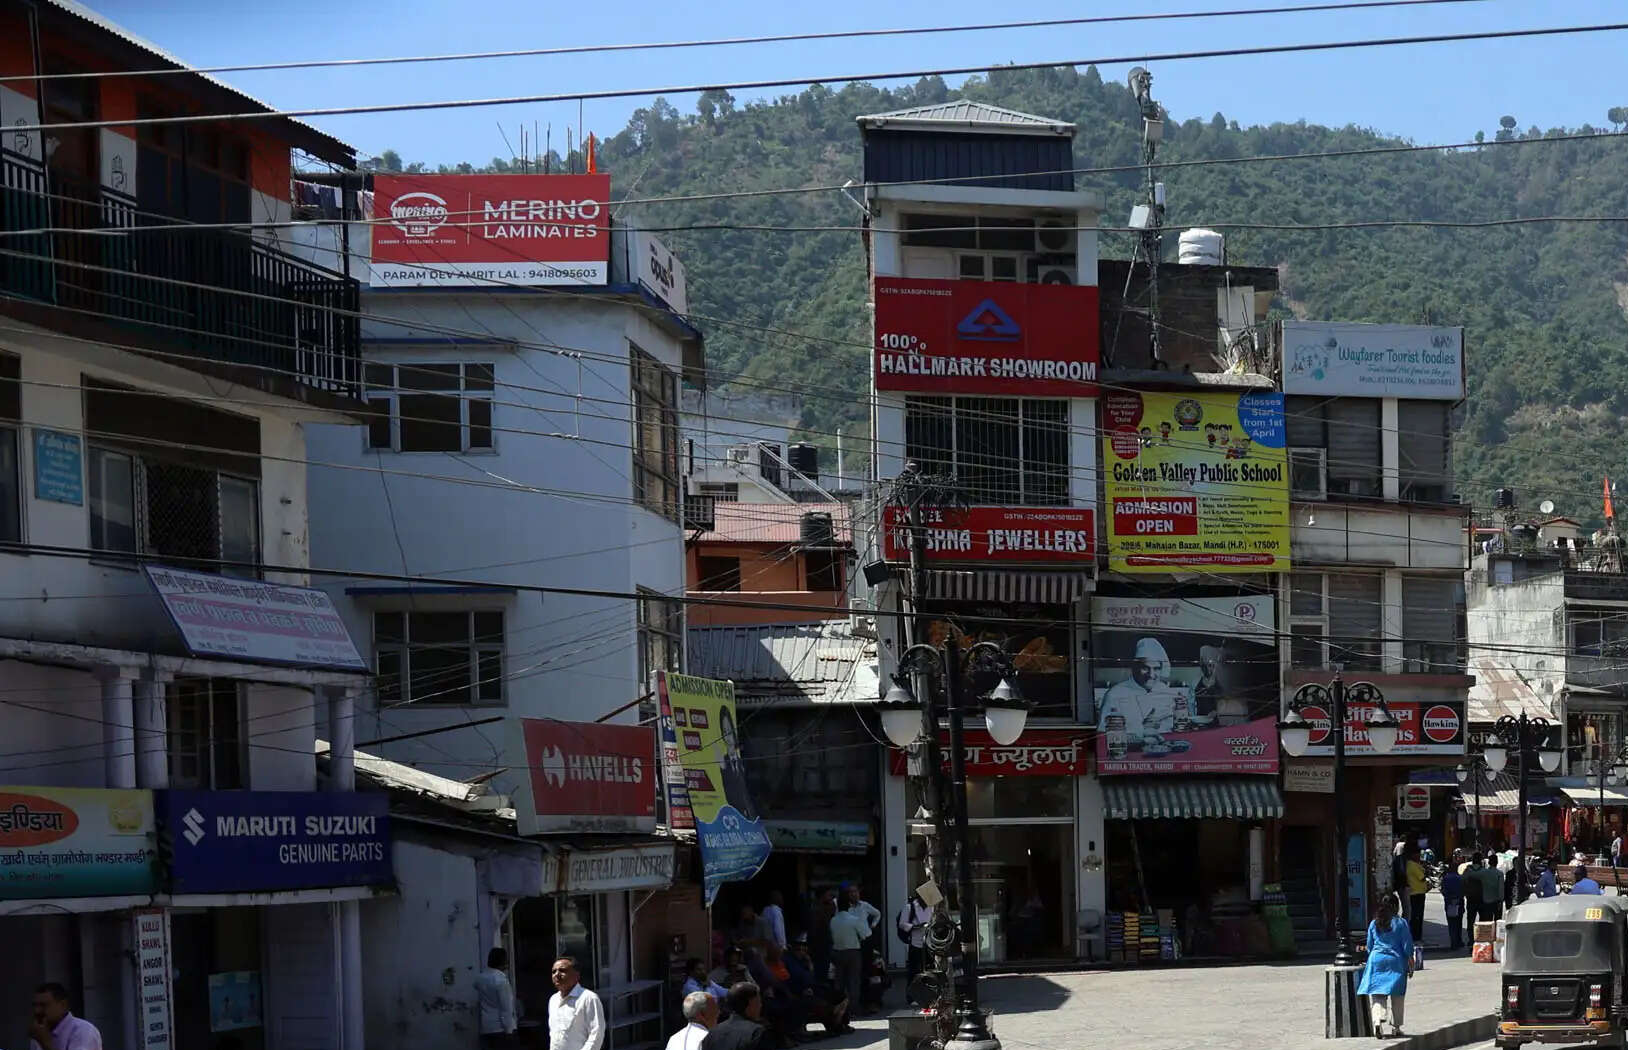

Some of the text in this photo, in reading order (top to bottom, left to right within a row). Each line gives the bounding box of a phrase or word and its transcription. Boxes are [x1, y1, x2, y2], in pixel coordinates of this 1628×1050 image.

[484, 200, 600, 220] MERINO
[484, 225, 598, 238] LAMINATES
[384, 268, 597, 280] PARAM DEV AMRIT LAL 9418095603
[1338, 347, 1456, 366] Wayfarer Tourist foodies
[880, 353, 1096, 381] HALLMARK SHOWROOM
[1243, 398, 1281, 406] Classes
[1251, 408, 1274, 416] Start
[1243, 419, 1283, 427] from 1st
[1252, 429, 1275, 438] April
[1113, 463, 1282, 485] Golden Valley Public School
[1115, 501, 1193, 515] ADMISSION
[893, 509, 943, 524] SHEE
[1136, 519, 1174, 533] OPEN
[893, 528, 1087, 554] KRSHNA JEWELLERS
[1145, 541, 1177, 551] Mahajan
[1204, 541, 1226, 549] Mandi
[1253, 541, 1280, 549] 175001
[670, 675, 713, 697] ADMISSION
[715, 682, 733, 700] OPEN
[1424, 719, 1459, 729] Hawkins
[1344, 725, 1414, 743] Hawns
[567, 755, 642, 783] HAVELLS
[216, 814, 376, 837] MARUTI SUZUKI
[279, 842, 384, 864] GENUINE PARTS
